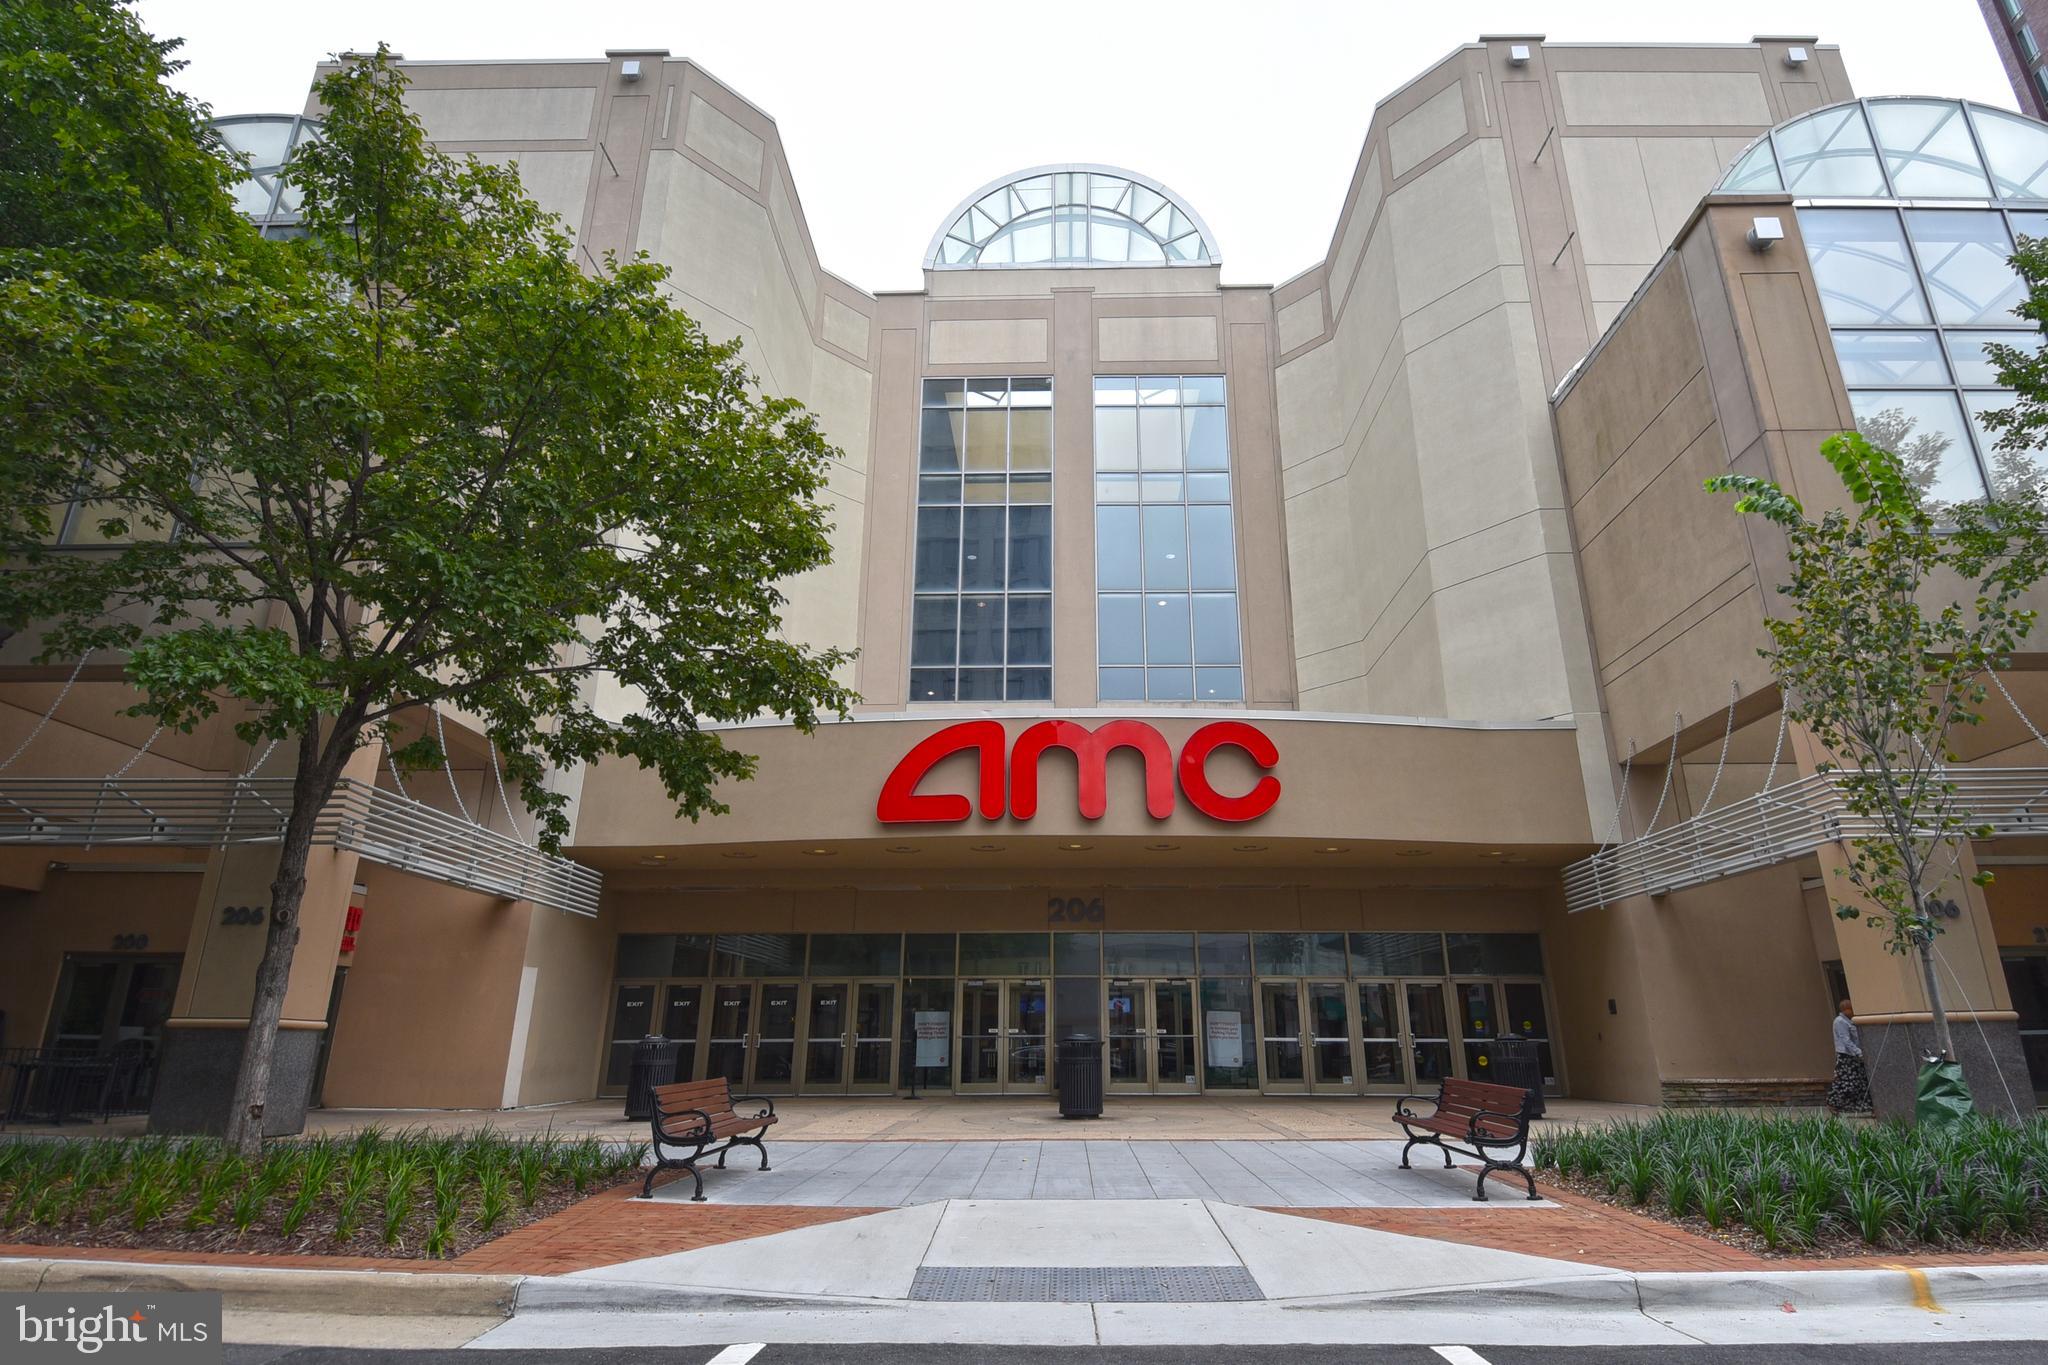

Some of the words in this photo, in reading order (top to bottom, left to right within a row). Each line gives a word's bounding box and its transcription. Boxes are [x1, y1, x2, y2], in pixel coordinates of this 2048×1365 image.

[221, 906, 264, 926] 206
[1048, 896, 1104, 922] 206
[1924, 899, 1960, 919] 06
